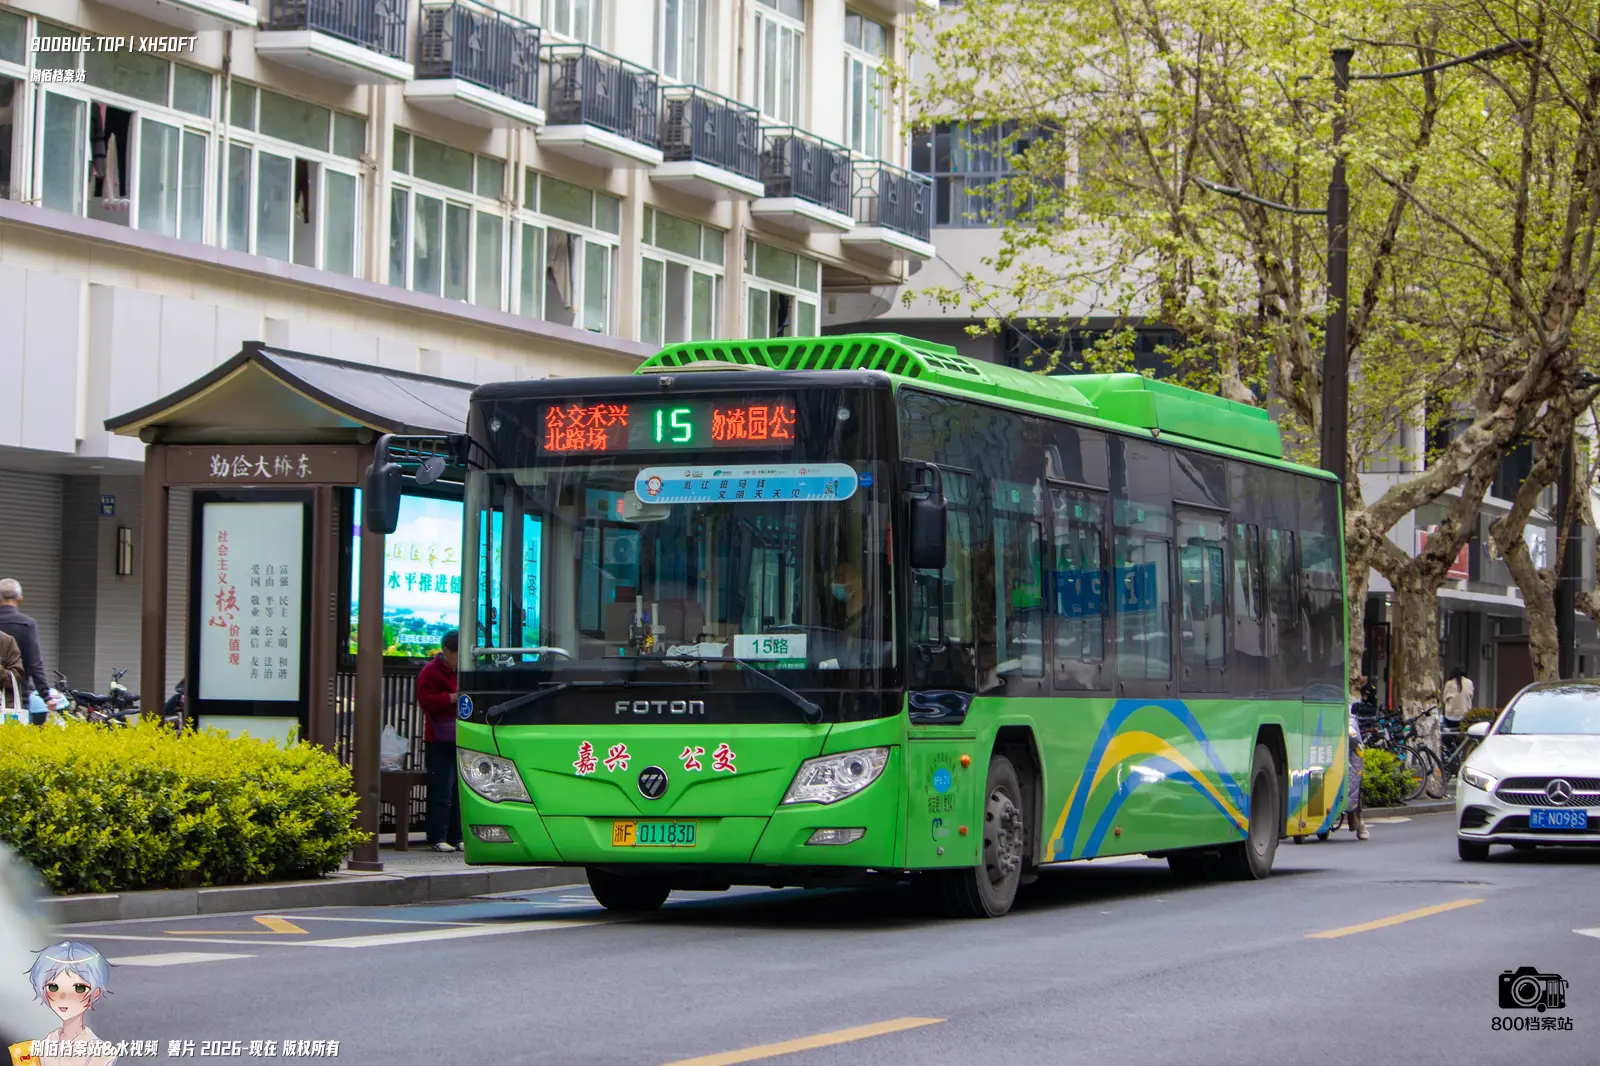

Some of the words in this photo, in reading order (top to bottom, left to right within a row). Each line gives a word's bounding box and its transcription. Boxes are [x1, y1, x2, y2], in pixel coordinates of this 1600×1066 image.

[545, 404, 630, 428] 公交禾兴
[656, 409, 692, 443] 15
[711, 406, 796, 441] 物流园公
[544, 428, 609, 451] 北路场
[209, 453, 313, 479] 勤俭大桥东
[717, 488, 800, 499] 文明天天见
[250, 564, 260, 587] 爱国
[265, 564, 274, 587] 自由
[279, 564, 289, 587] 富强
[216, 529, 229, 585] 社会主义
[228, 624, 240, 666] 价值观
[250, 595, 260, 617] 敬业
[265, 595, 274, 618] 平等
[279, 595, 289, 618] 民主
[250, 626, 260, 648] 诚信
[264, 626, 274, 648] 公正
[278, 626, 288, 648] 文明
[752, 639, 788, 655] 15路
[249, 656, 259, 679] 友善
[263, 656, 273, 679] 法治
[278, 656, 288, 679] 和谐
[615, 700, 704, 715] FOTON
[573, 740, 631, 776] 嘉兴
[679, 742, 737, 774] 公交
